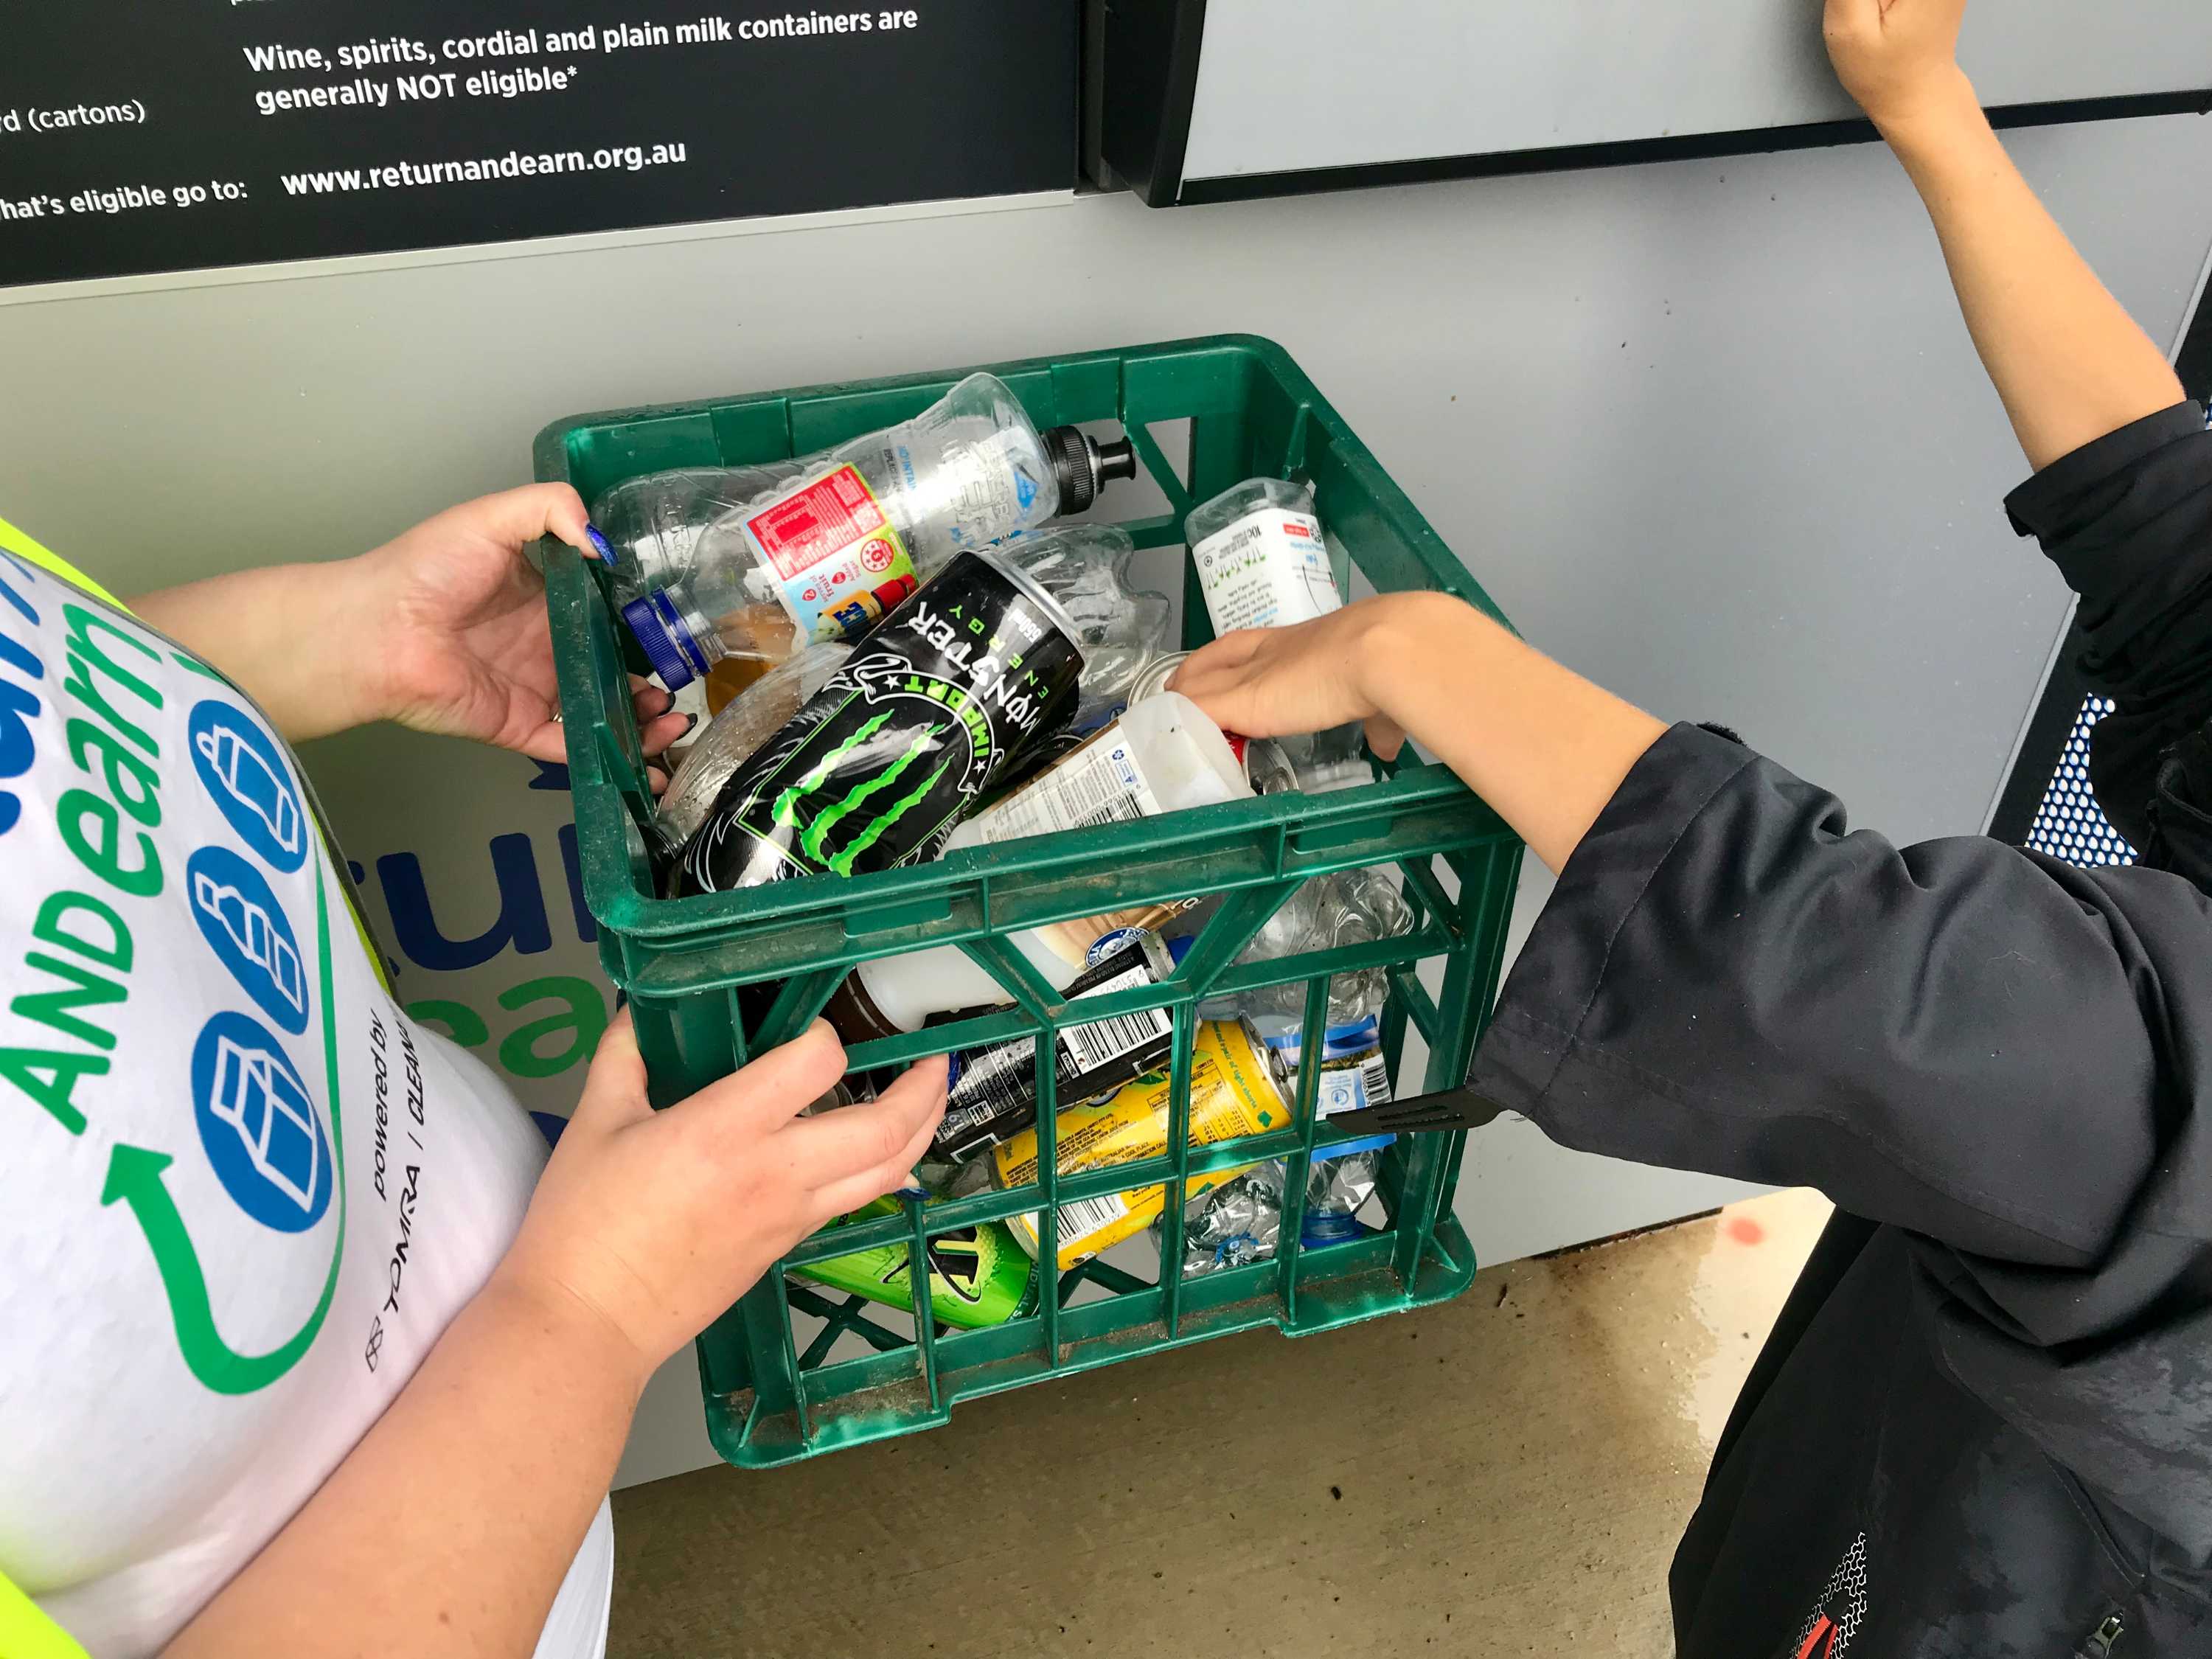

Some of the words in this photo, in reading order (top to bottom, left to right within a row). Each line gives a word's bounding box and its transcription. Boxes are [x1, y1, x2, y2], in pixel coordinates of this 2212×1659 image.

[243, 44, 332, 72] Wine,
[337, 37, 436, 70] spirits,
[442, 29, 538, 60] cordial
[545, 24, 597, 52] and
[602, 21, 669, 53] plain
[675, 16, 733, 44] milk
[738, 10, 873, 40] containers
[878, 10, 918, 30] are
[27, 99, 145, 133] (cartons)
[255, 78, 389, 115] generally
[396, 73, 456, 101] NOT
[69, 184, 167, 214] eligible
[173, 185, 206, 208] go
[211, 180, 248, 201] to:
[280, 143, 686, 195] www.returnandearn.org.au
[815, 573, 835, 597] fruit
[901, 601, 1043, 736] MONSTER
[948, 605, 1050, 699] ENERGY
[56, 602, 165, 897] earn
[904, 674, 990, 759] IMPORT
[0, 889, 135, 1136] AND
[370, 1007, 388, 1054] by
[371, 1047, 389, 1203] powered
[383, 1165, 421, 1313] TOMRA
